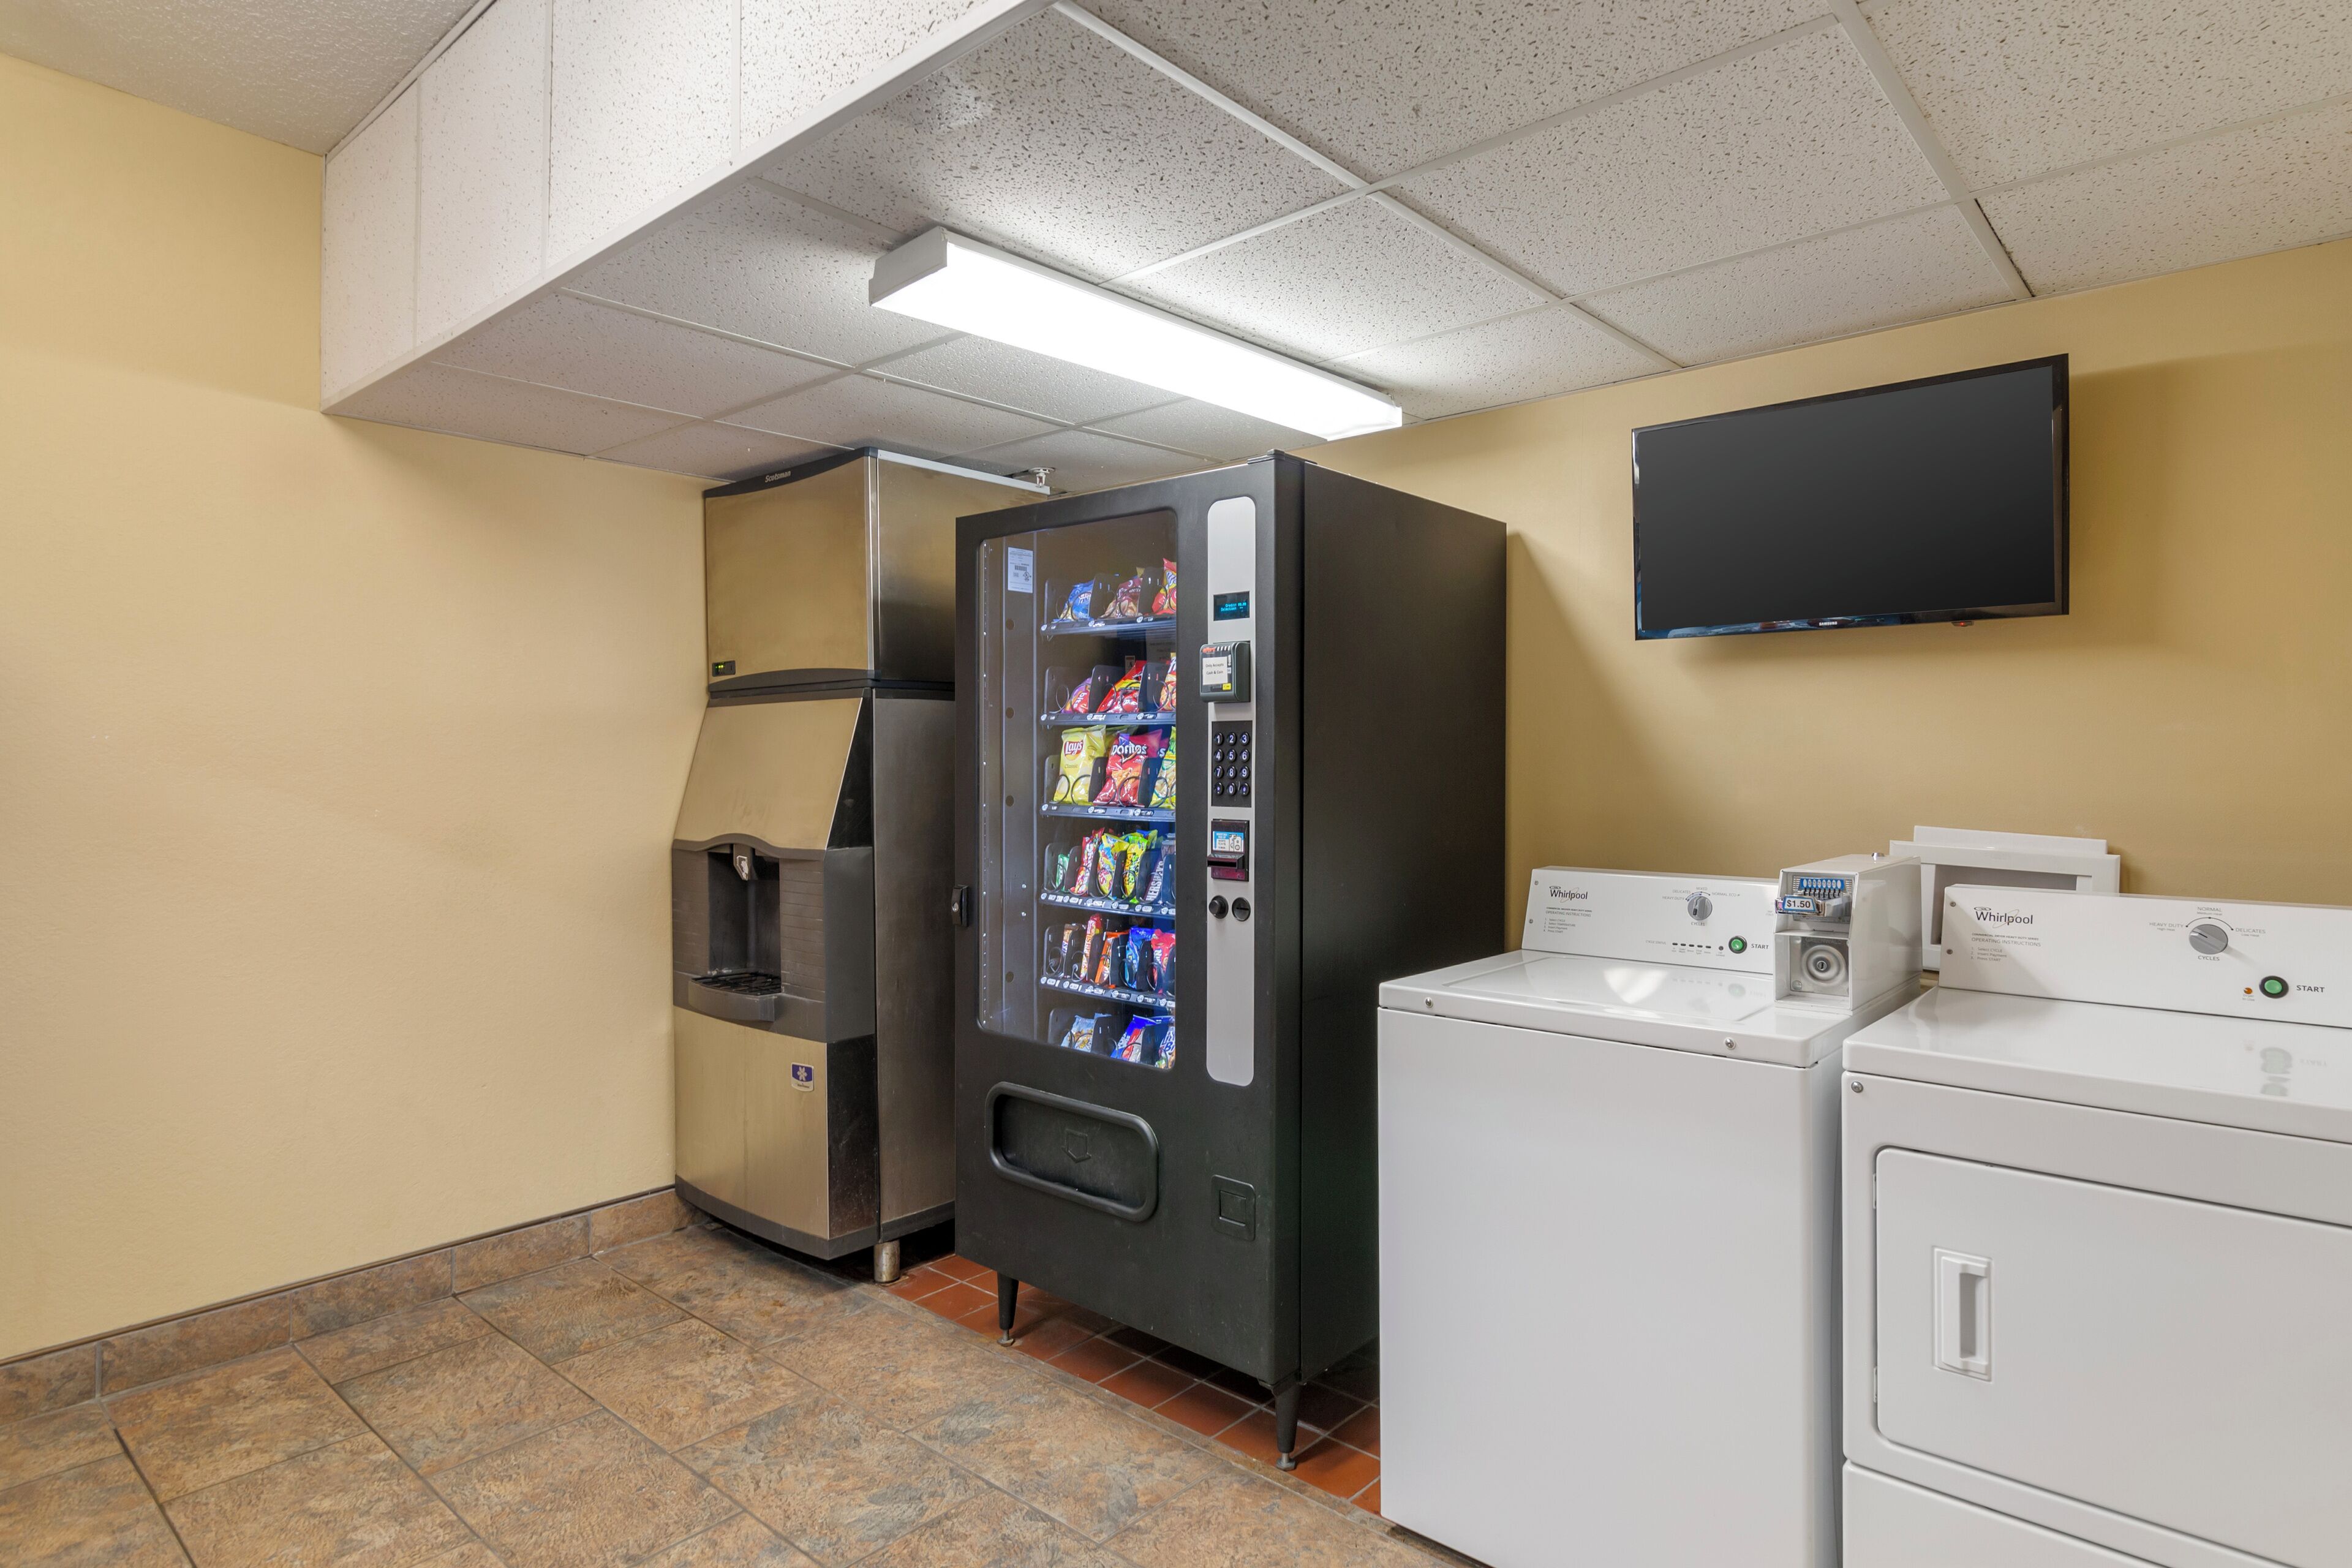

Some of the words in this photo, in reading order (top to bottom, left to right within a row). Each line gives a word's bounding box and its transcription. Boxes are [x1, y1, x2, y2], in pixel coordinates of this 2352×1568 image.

[765, 470, 791, 483] Scotsman
[1111, 741, 1147, 755] Doritos
[1216, 768, 1220, 777] 7
[1229, 768, 1234, 777] 8
[1550, 889, 1588, 900] Whirlpool
[1787, 900, 1811, 908] $1.50
[1975, 911, 2033, 925] Whirlpool
